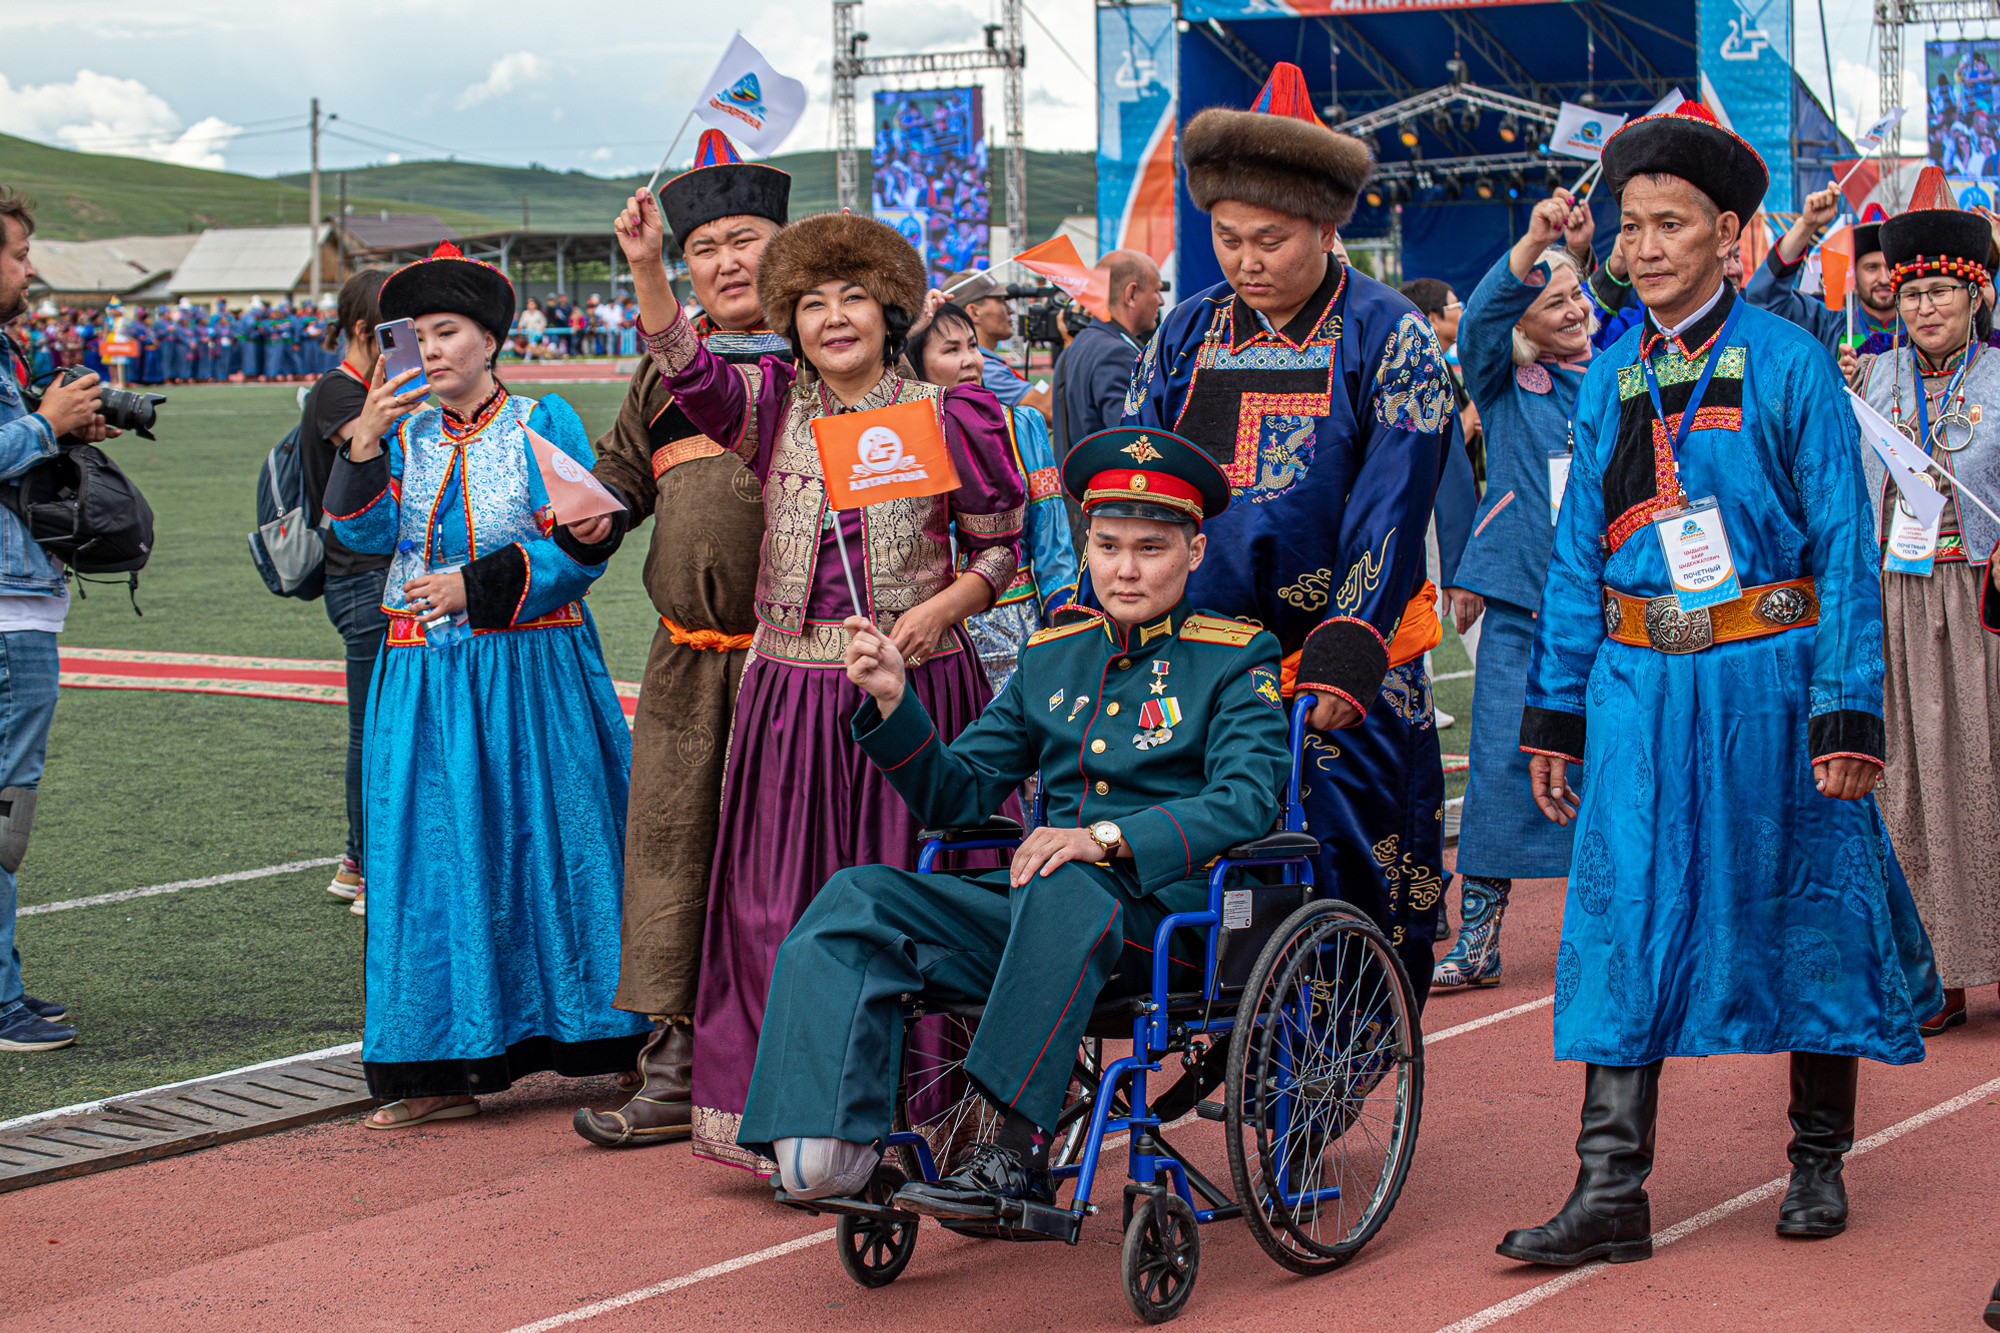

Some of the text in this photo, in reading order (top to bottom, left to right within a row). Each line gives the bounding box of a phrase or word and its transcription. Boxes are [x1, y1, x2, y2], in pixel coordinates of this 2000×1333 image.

[1680, 531, 1705, 541] АЛТАРГАНА
[1683, 545, 1709, 556] ЦЫДЫПОВ
[1896, 542, 1926, 550] ПОЧЕТНЫЙ
[1679, 554, 1720, 569] ЦЫДЕНЖАПОВИЧ
[1691, 552, 1704, 560] БАИР
[1683, 564, 1721, 580] ПОЧЕТНЫЙ
[1693, 574, 1715, 585] ГОСТЬ
